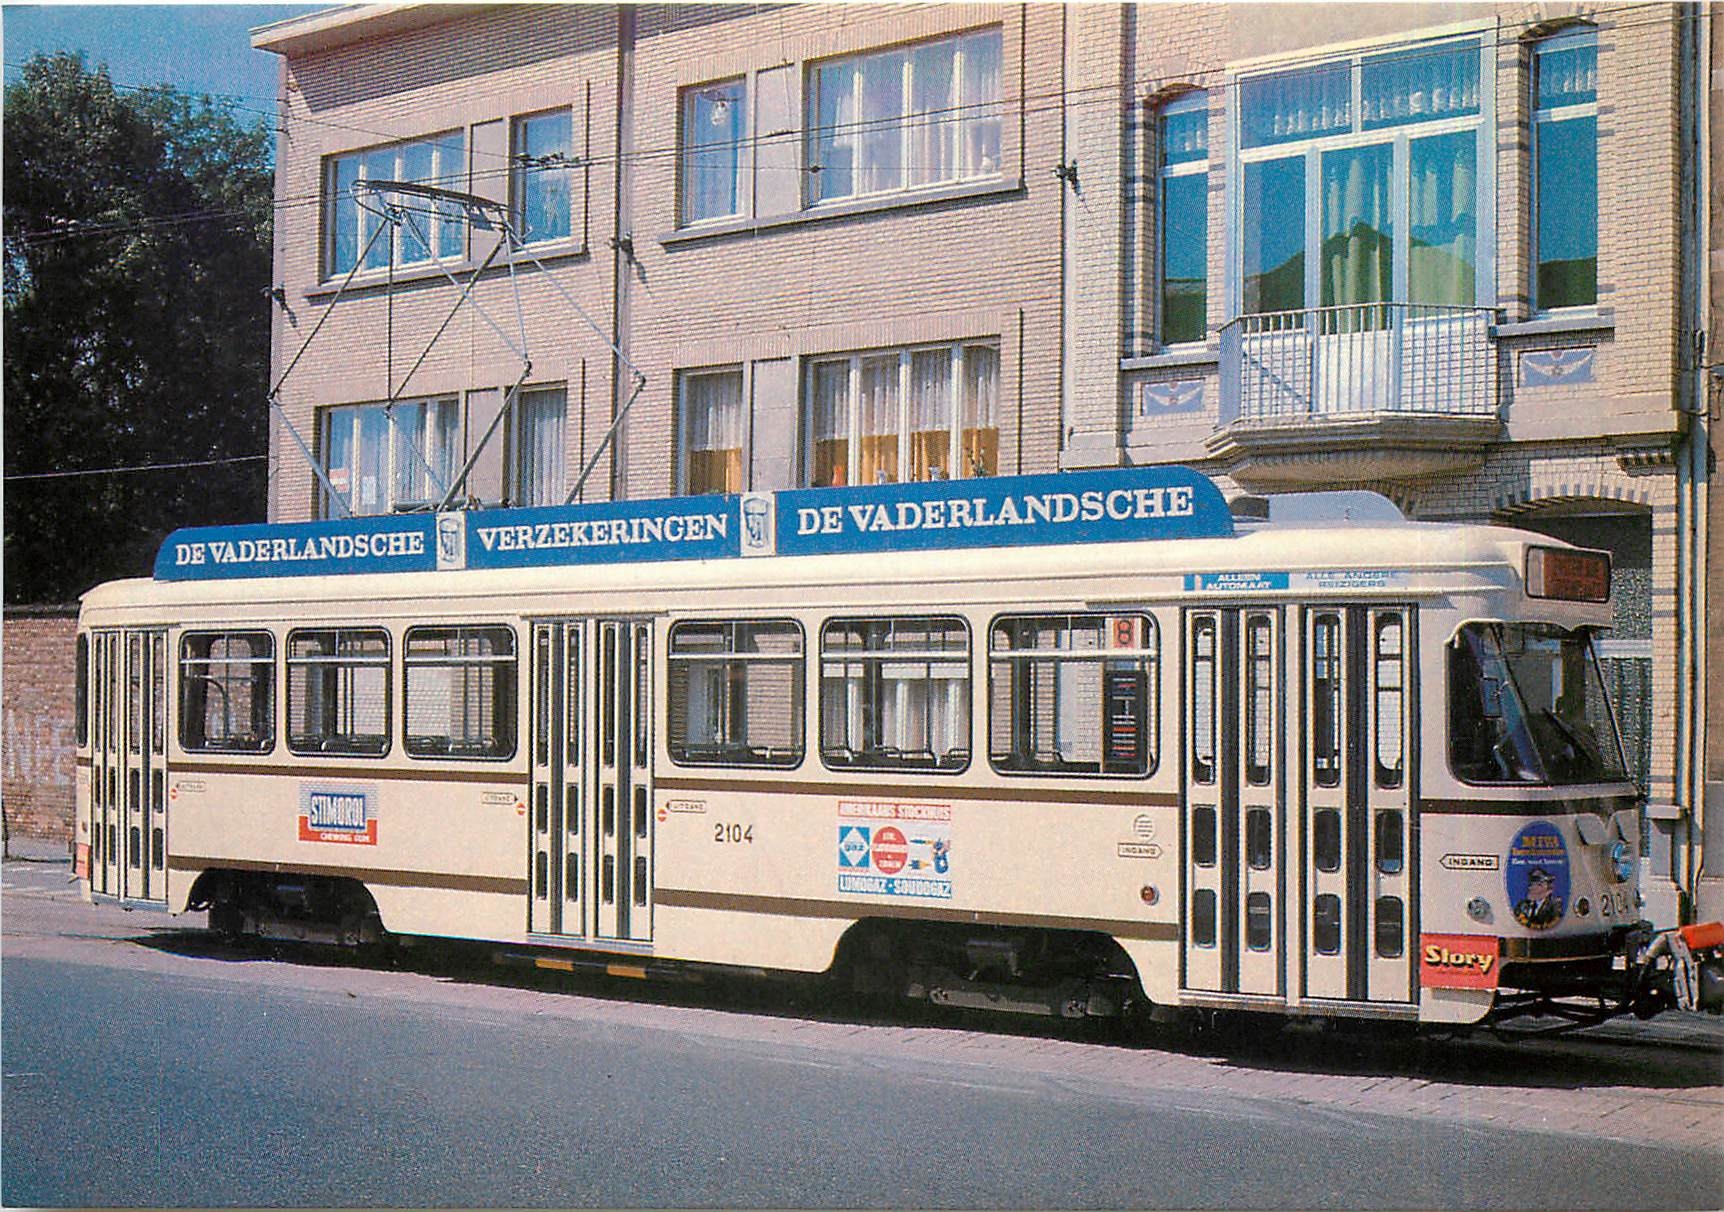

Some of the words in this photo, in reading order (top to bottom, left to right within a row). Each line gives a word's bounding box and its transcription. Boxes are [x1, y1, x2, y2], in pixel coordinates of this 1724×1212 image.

[798, 508, 842, 535] DE
[854, 486, 1194, 532] VADERLANDSCHE
[476, 514, 728, 551] VERZEKERINGEN
[175, 544, 206, 565] DE
[208, 531, 425, 564] VADERLANDSCHE
[1206, 581, 1272, 590] AUTOMAAT
[1118, 619, 1132, 645] 8
[311, 795, 364, 827] STIMOROL
[714, 823, 753, 843] 2104
[1447, 857, 1493, 867] INGANG
